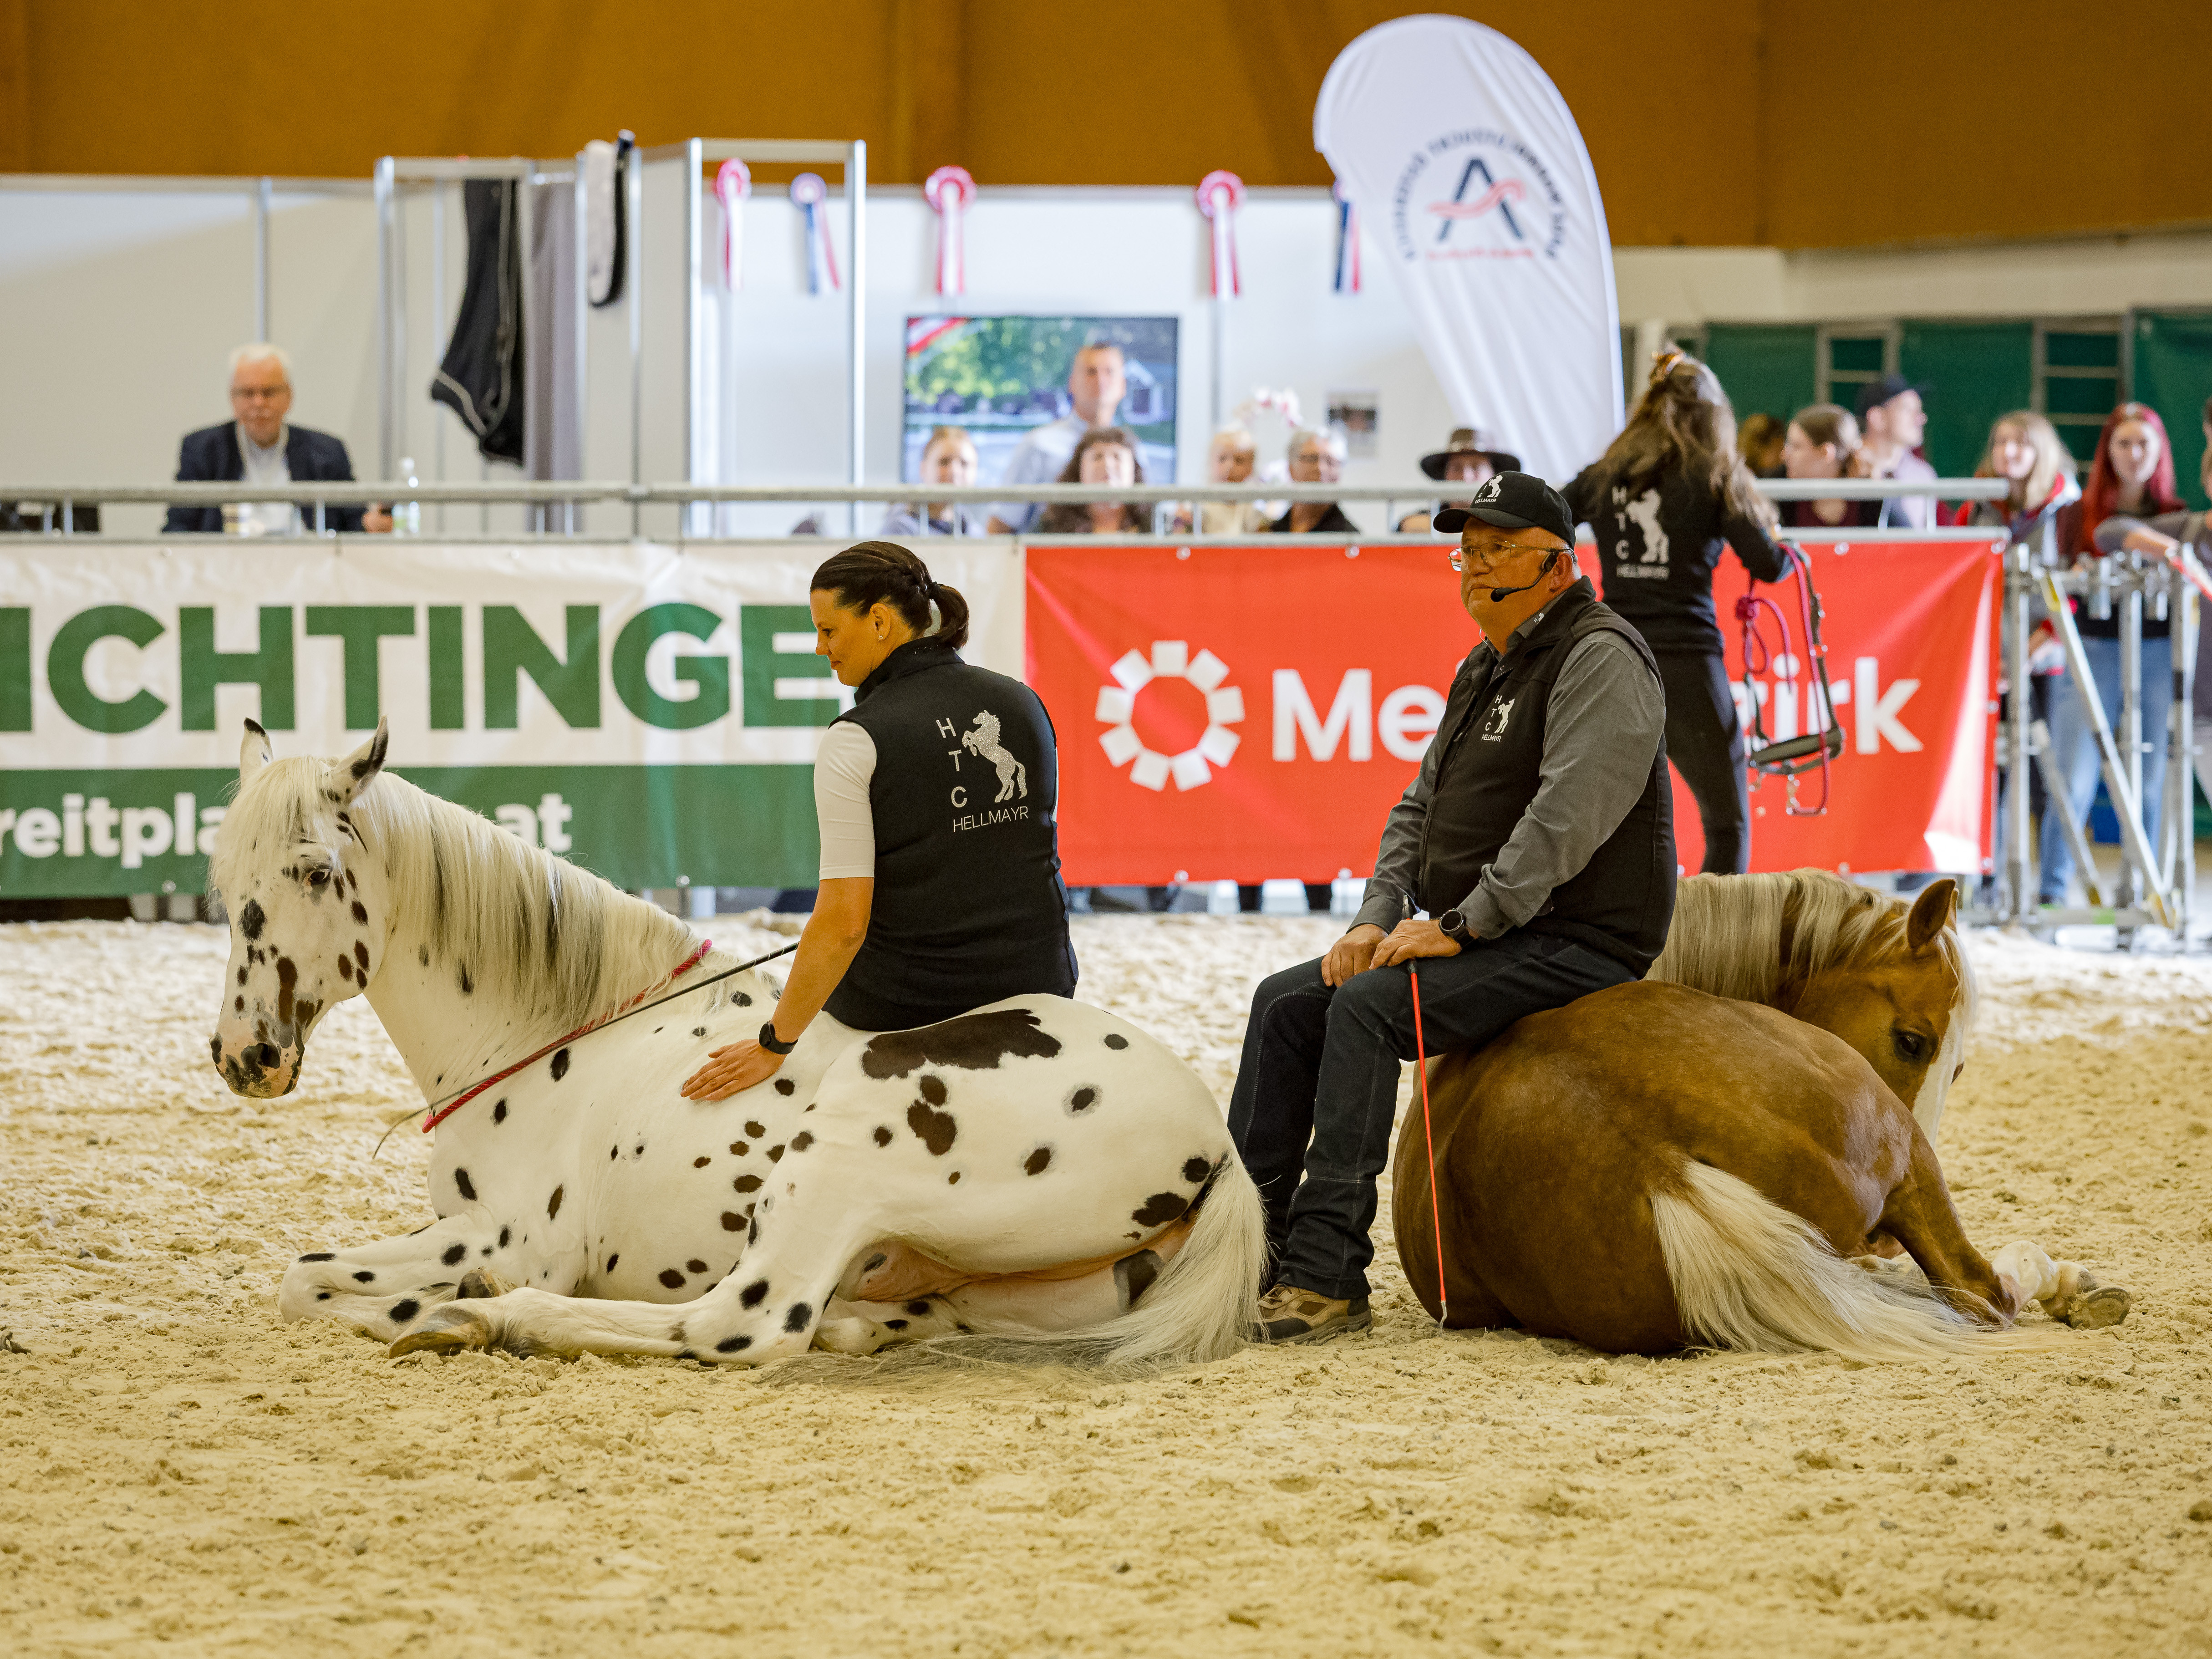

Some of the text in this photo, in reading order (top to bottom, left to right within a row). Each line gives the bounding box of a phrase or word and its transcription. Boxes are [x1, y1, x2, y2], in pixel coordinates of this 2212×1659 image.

[0, 602, 859, 734] ICHTINGE
[1272, 658, 1469, 762] Me
[1481, 734, 1502, 742] HELLMAYR
[1485, 695, 1503, 731] HTC
[936, 718, 967, 808] HTC
[953, 806, 1029, 833] HELLMAYR
